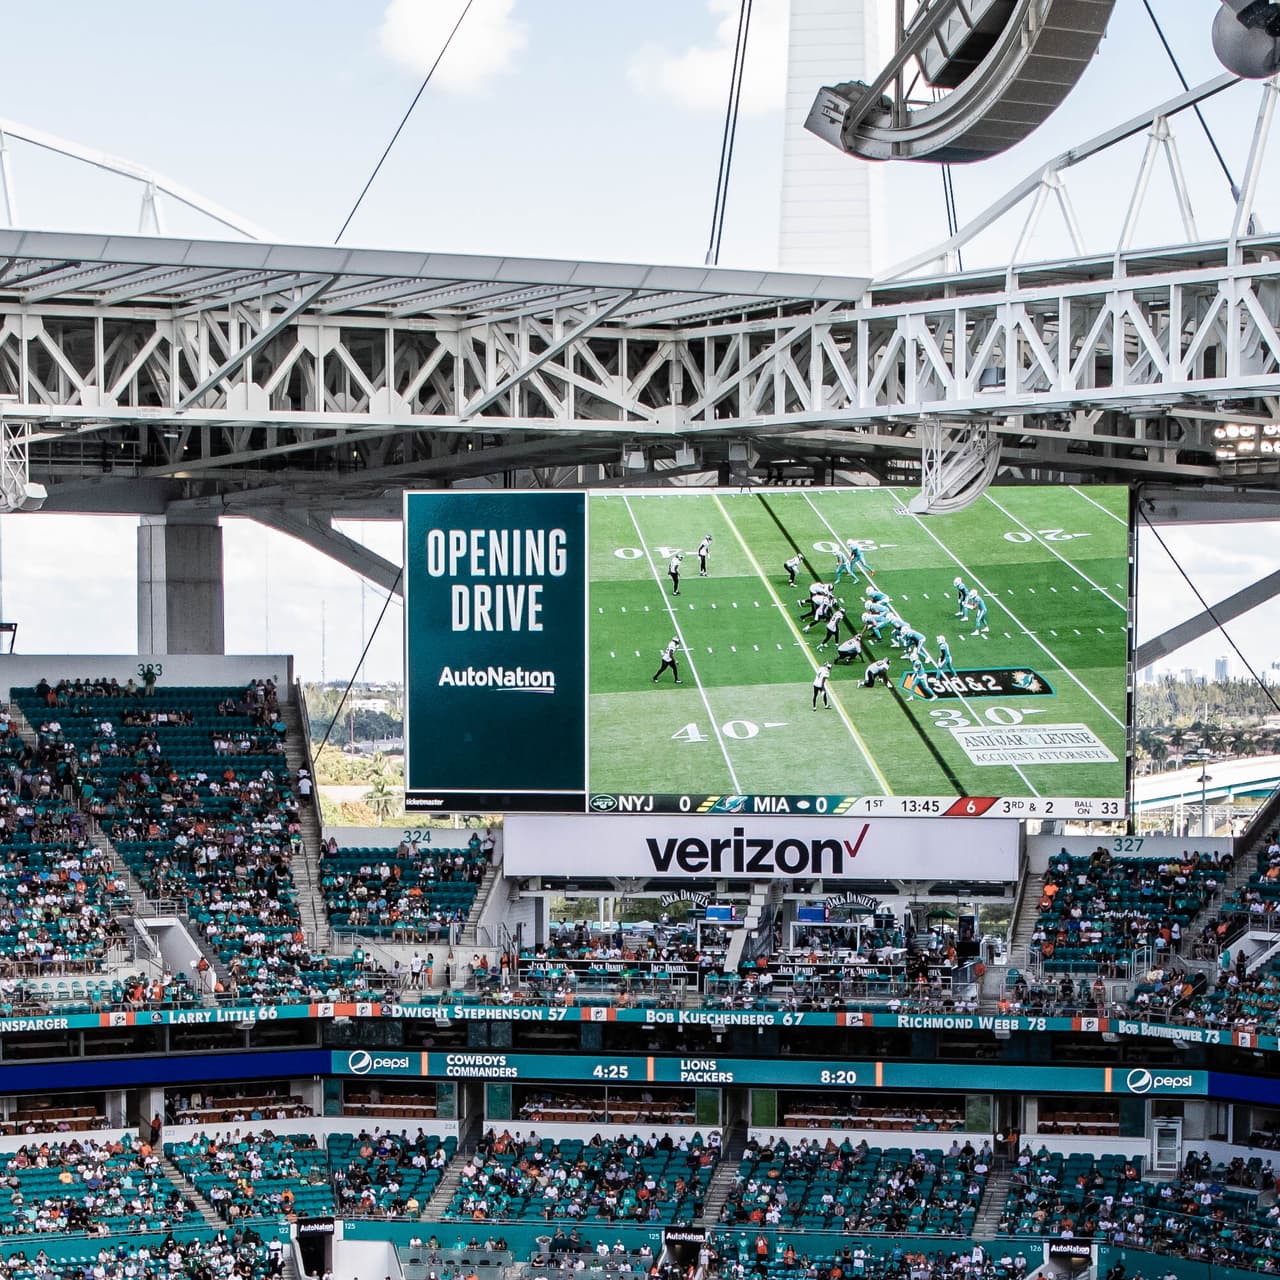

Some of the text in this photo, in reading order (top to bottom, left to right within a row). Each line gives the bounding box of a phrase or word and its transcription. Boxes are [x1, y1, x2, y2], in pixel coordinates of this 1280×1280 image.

[427, 529, 567, 578] OPENING
[451, 584, 544, 632] DRIVE
[438, 666, 555, 689] AutoNation
[1040, 733, 1096, 745] LEVINE
[1038, 751, 1109, 760] ATTORNEYS
[618, 795, 691, 812] NYJ 0
[754, 796, 827, 814] MIA 0
[865, 800, 1054, 814] 1ST 13:45 6 3RD & 2
[1102, 802, 1118, 814] 33
[402, 830, 432, 844] 324
[646, 828, 844, 876] verizon
[1113, 838, 1144, 852] 327
[170, 1006, 278, 1025] LARRY LITTLE 66
[392, 1005, 567, 1021] DWIGHT STEPHENSON 57
[646, 1010, 804, 1026] BOB KUECHENBERG 67
[898, 1014, 1047, 1031] RICHMOND WEBB 78
[1119, 1021, 1220, 1044] BOB BAUMHOWER 73
[373, 1057, 409, 1071] pepsi
[446, 1055, 506, 1066] COWBOYS
[680, 1060, 716, 1071] LIONS
[446, 1066, 518, 1078] COMMANDERS
[593, 1065, 628, 1079] 4:25
[680, 1071, 734, 1083] PACKERS
[821, 1070, 856, 1084] 8:20
[1154, 1075, 1192, 1089] pepsi
[648, 1232, 659, 1240] 125
[1051, 1244, 1090, 1254] AutoNation
